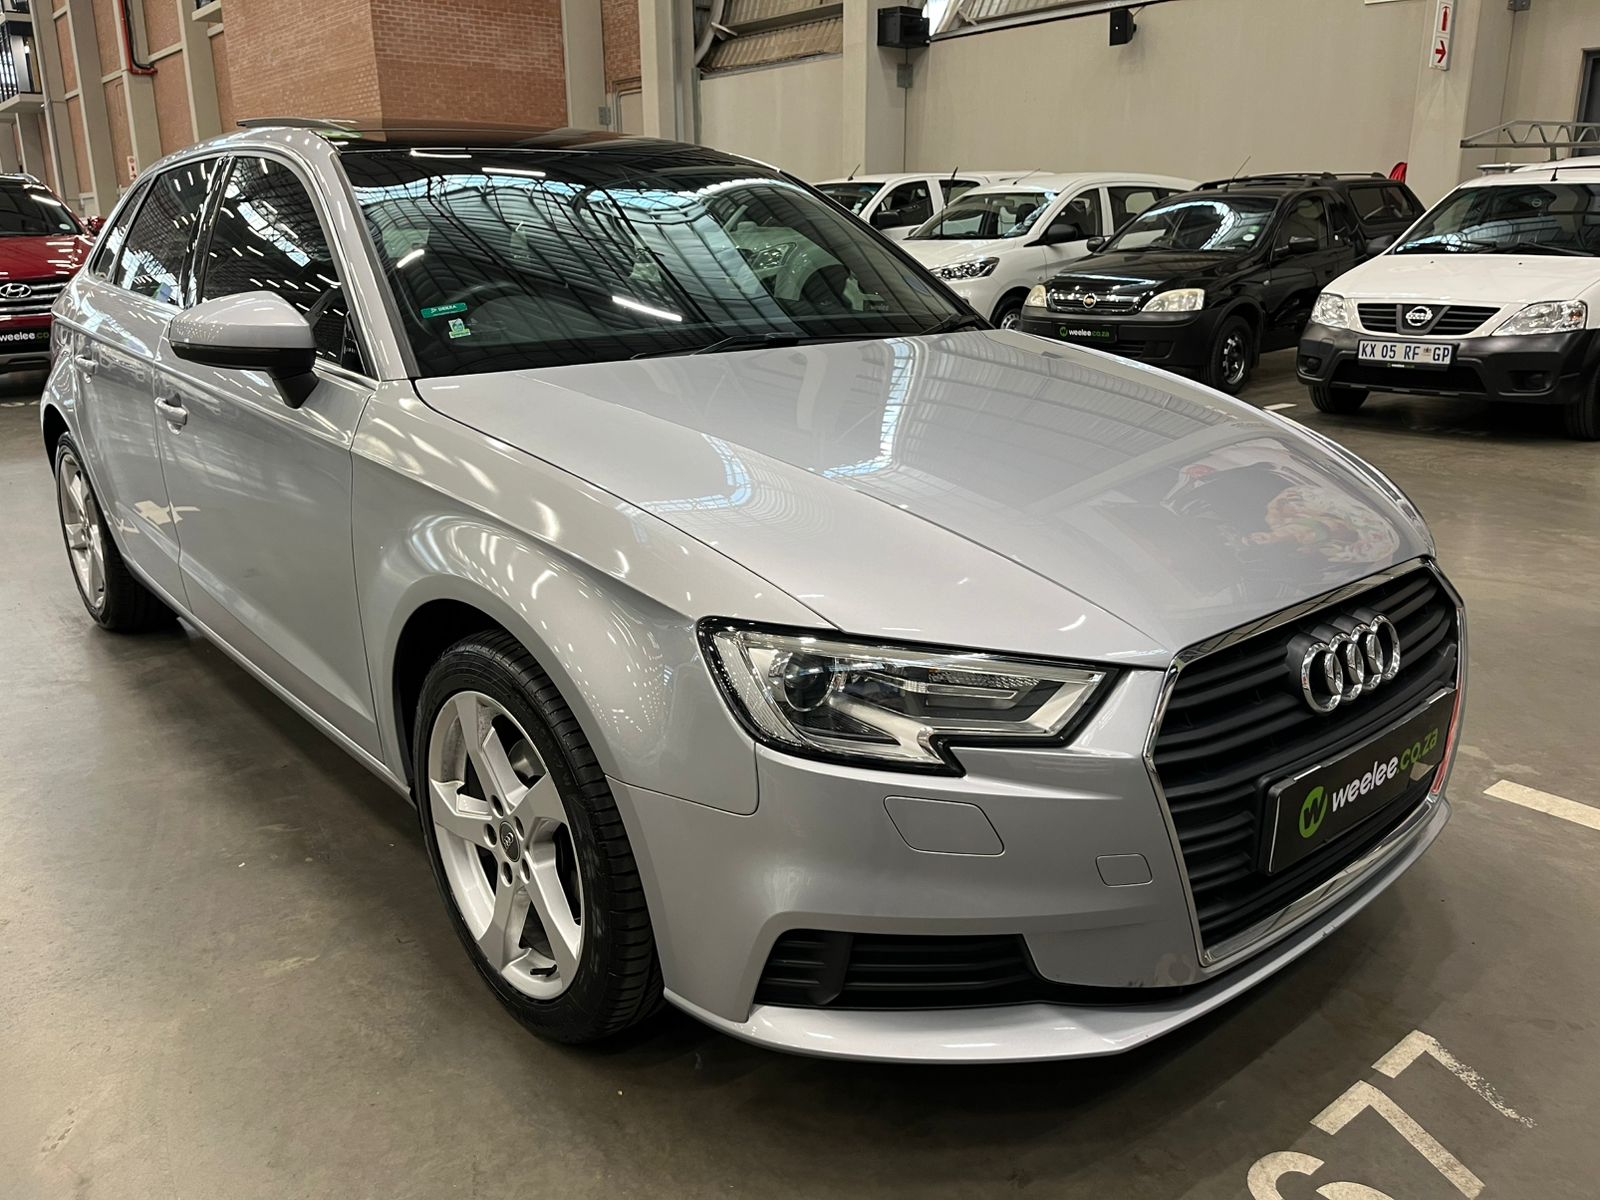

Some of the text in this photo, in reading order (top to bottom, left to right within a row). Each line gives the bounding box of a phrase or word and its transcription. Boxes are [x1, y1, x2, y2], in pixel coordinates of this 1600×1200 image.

[1361, 343, 1450, 362] KX 05 RF GP
[1331, 727, 1439, 813] weelee.co.za
